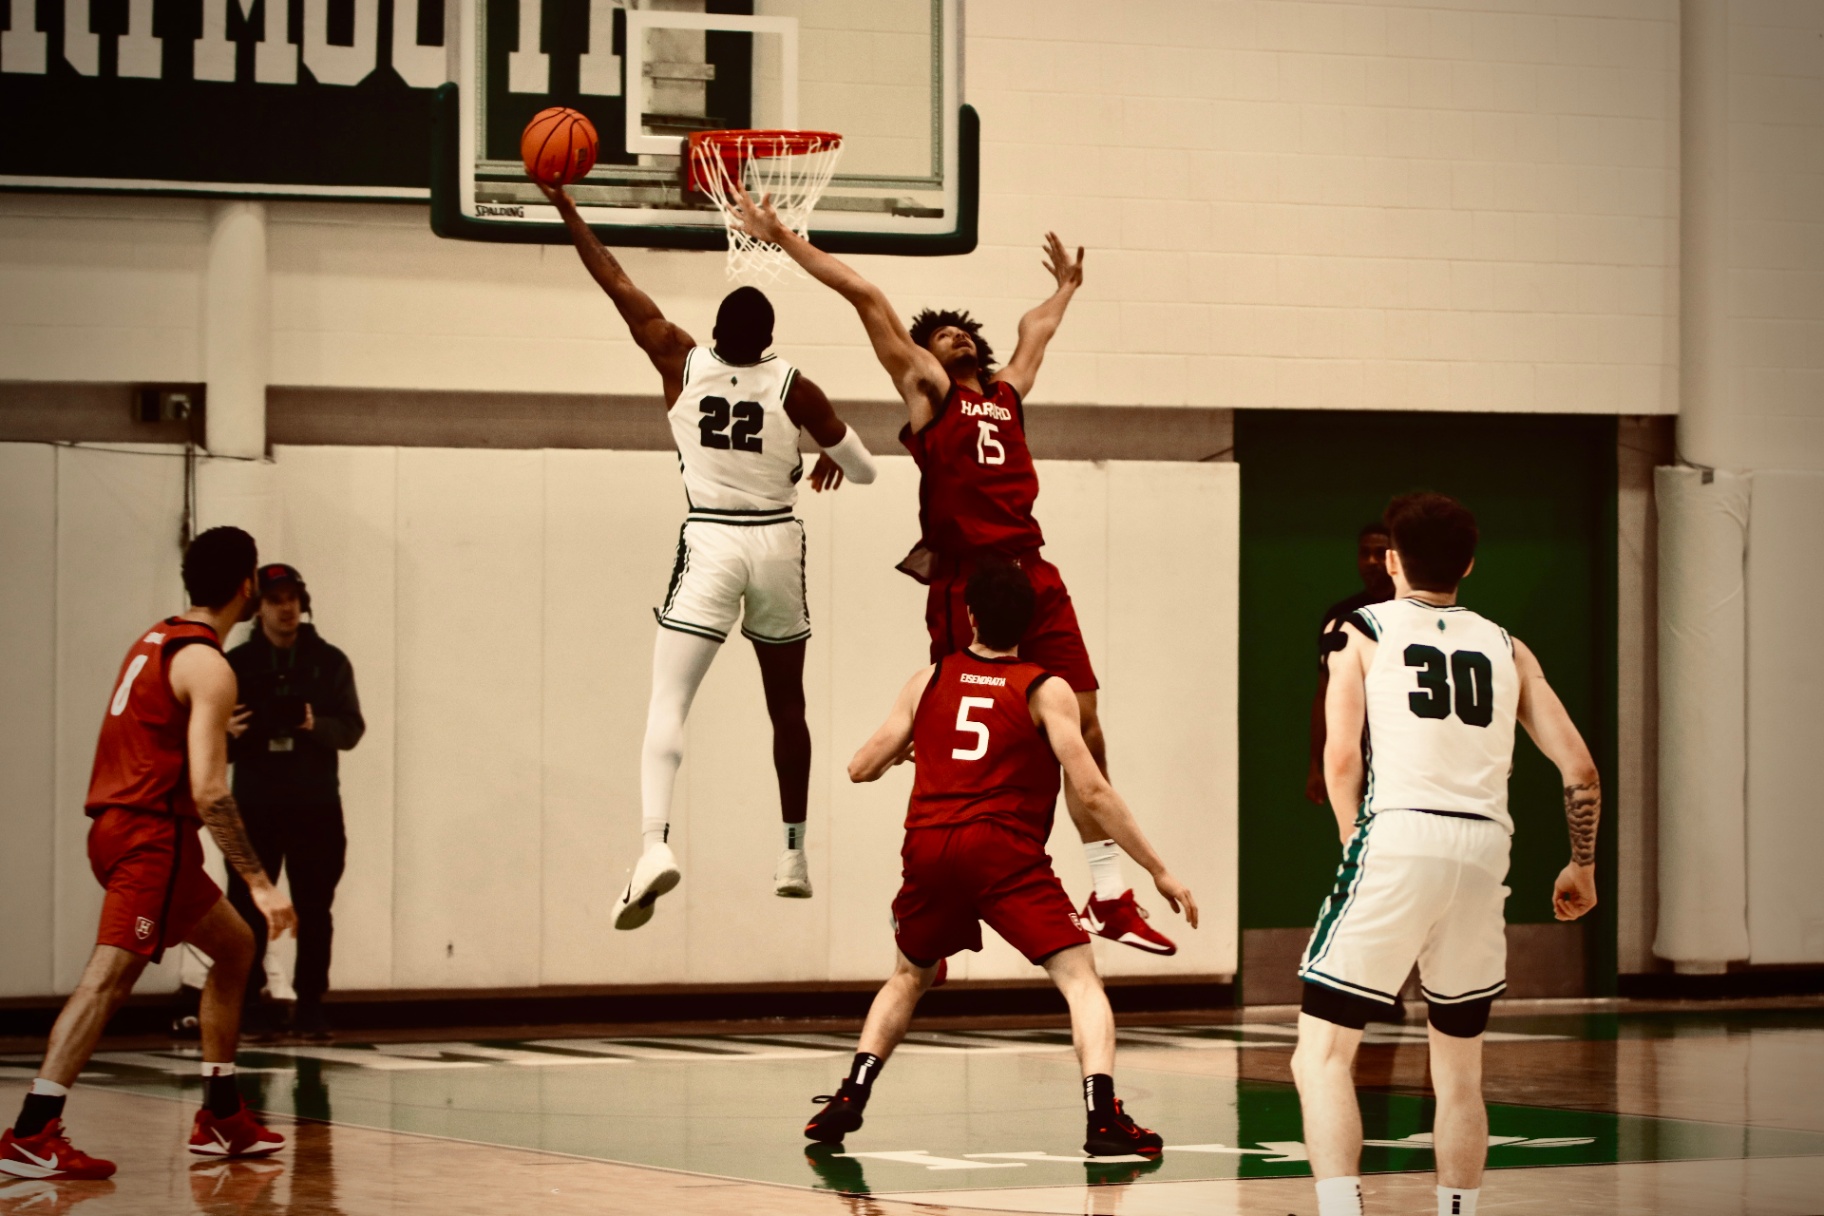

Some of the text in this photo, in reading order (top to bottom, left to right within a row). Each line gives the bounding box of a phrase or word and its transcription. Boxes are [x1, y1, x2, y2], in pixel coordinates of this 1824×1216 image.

[475, 205, 524, 218] SPALDING
[698, 395, 764, 454] 22
[976, 420, 1005, 465] 15
[960, 673, 1007, 687] EISENDRATH
[1403, 643, 1493, 728] 30
[951, 696, 995, 761] 5
